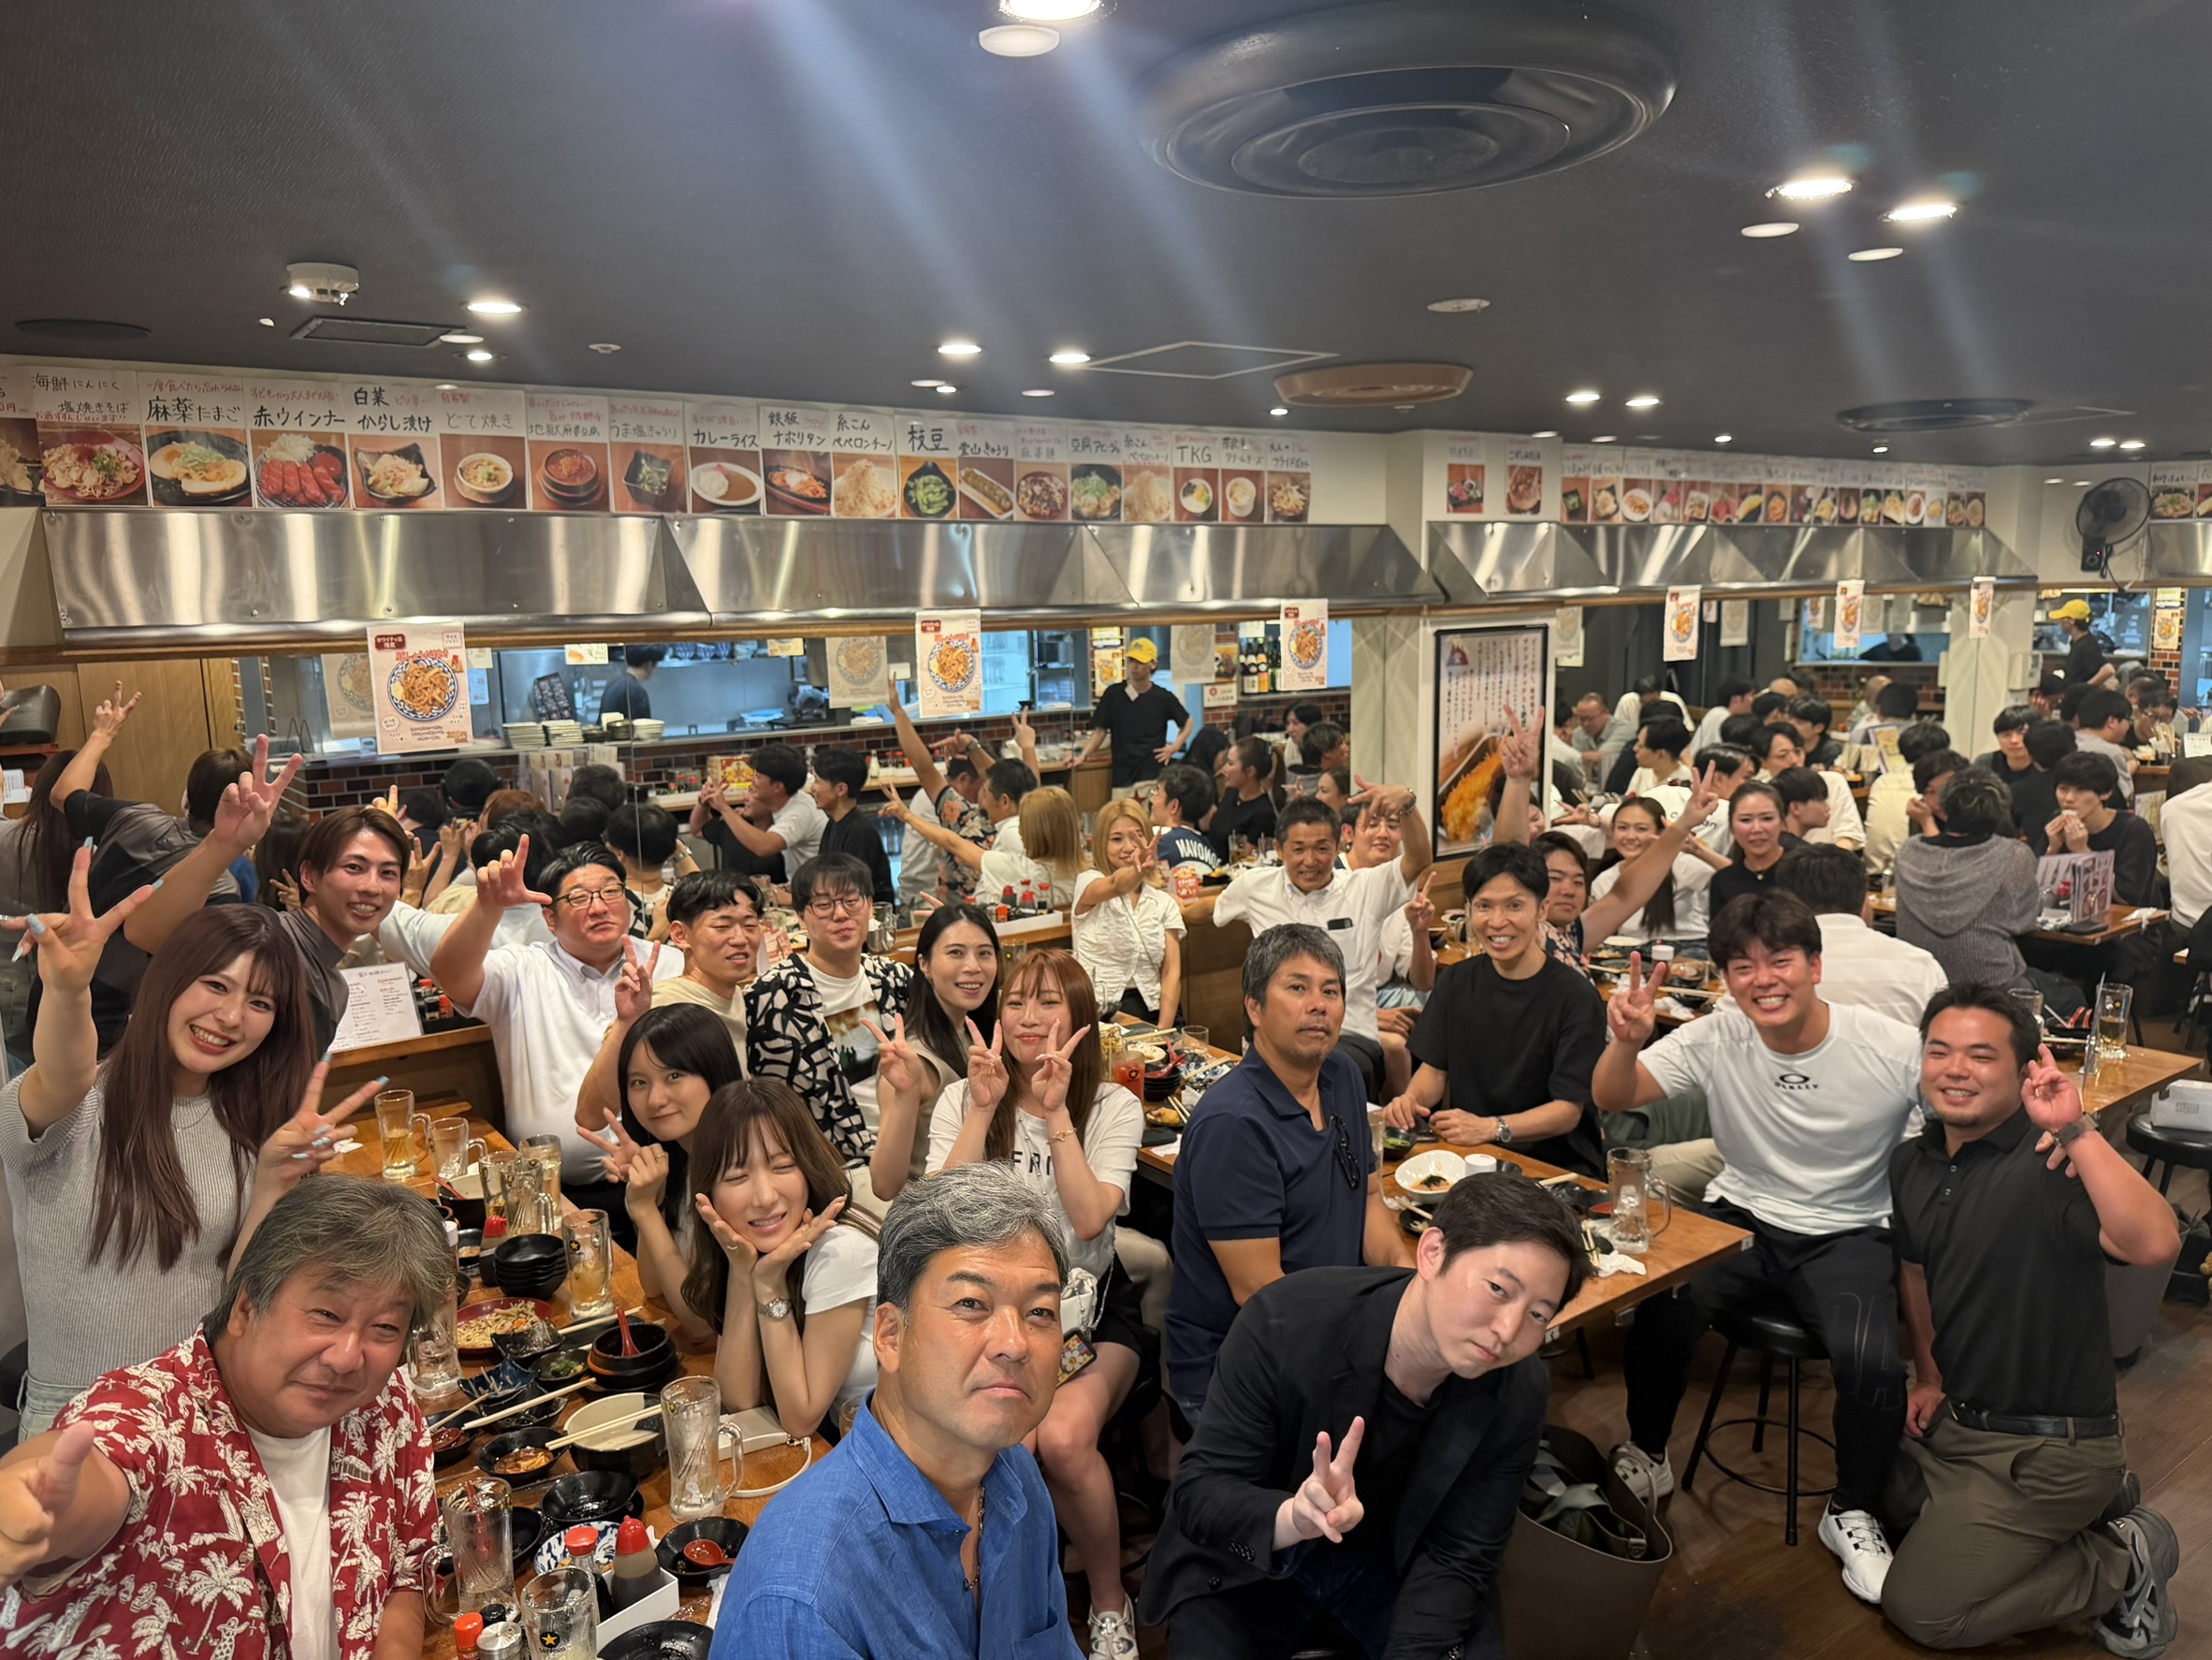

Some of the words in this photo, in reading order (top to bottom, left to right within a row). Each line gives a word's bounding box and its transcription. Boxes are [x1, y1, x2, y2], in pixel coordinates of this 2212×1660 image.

[31, 372, 120, 392] 海鮮にんにく
[354, 386, 389, 407] 白菜
[58, 400, 131, 414] 塩焼きそば
[146, 395, 240, 423] 麻薬たまご
[254, 405, 345, 428] 赤ウインナー
[357, 414, 432, 432] からし漬け
[446, 412, 514, 430] どて焼き
[768, 412, 800, 427] 鉄板
[837, 414, 870, 431] 糸こん
[693, 429, 759, 448] カレーライス
[774, 430, 826, 445] ナポリタン
[833, 436, 894, 451] ペペロンチーノ
[908, 425, 950, 452] 枝豆
[1175, 445, 1212, 464] TKG
[1774, 1082, 1818, 1090] OAKLEY
